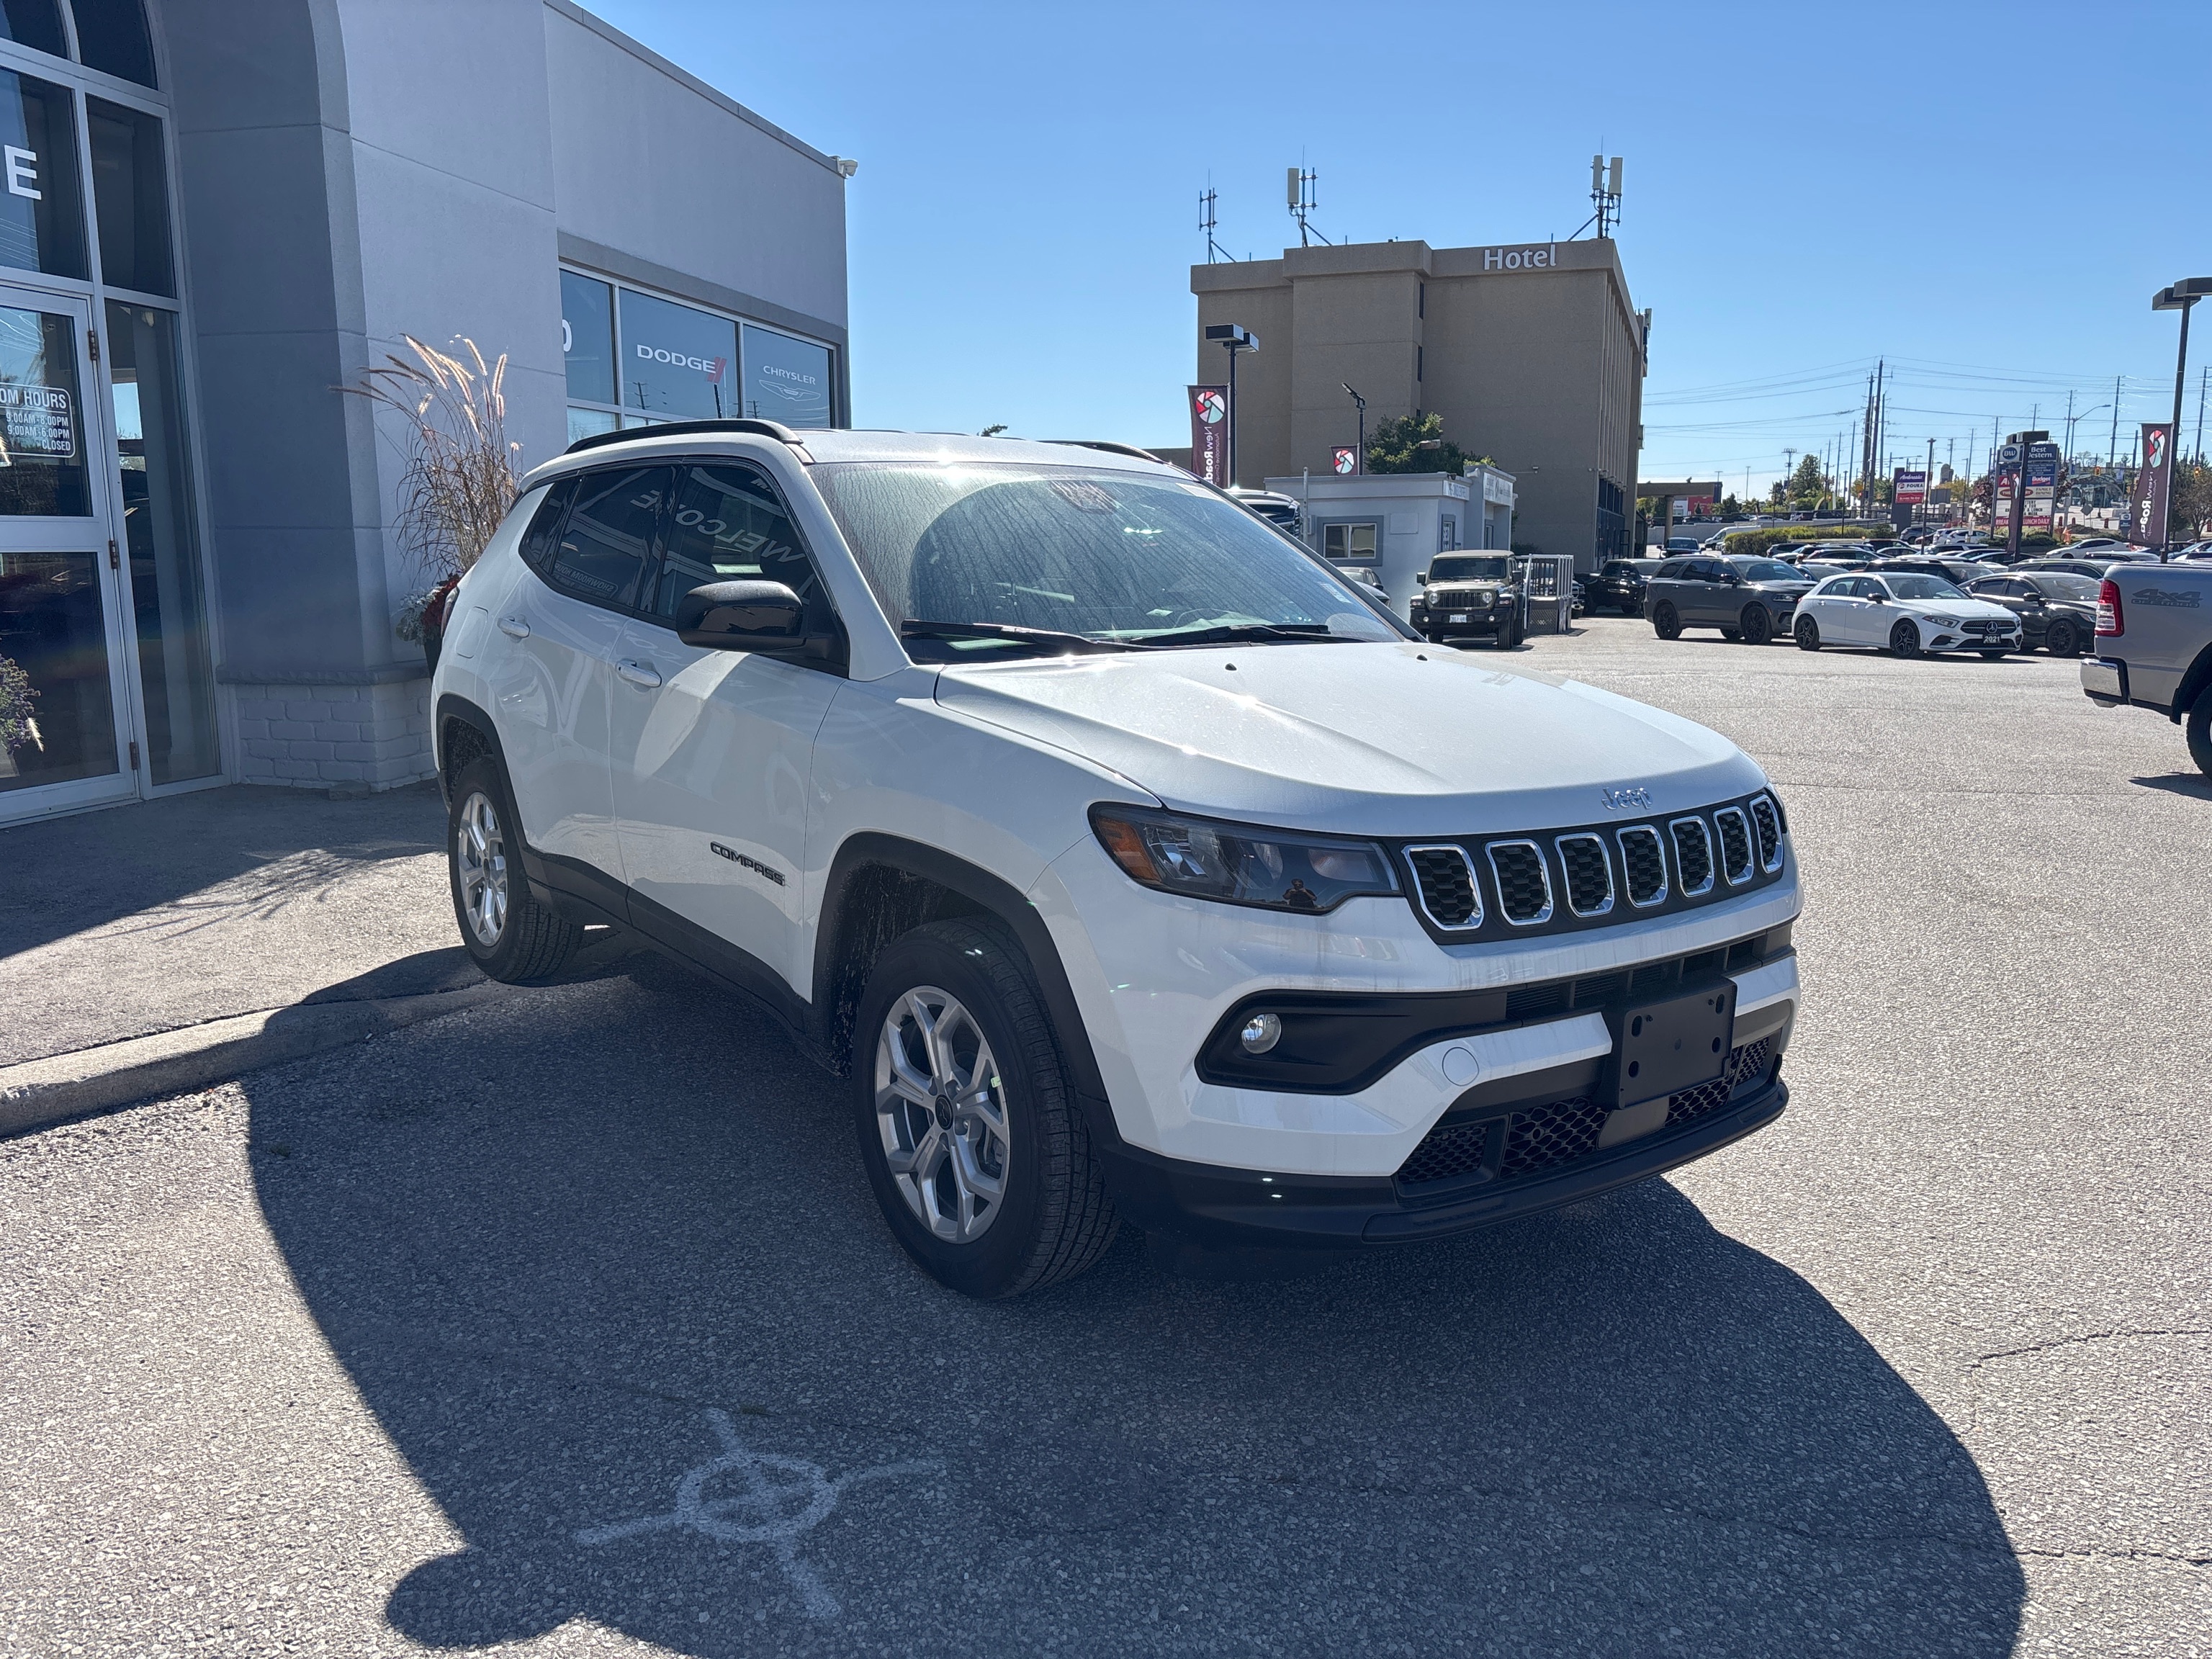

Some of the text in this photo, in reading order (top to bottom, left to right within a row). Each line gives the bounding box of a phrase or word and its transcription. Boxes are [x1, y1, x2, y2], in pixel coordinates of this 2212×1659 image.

[1484, 244, 1557, 270] Hotel
[637, 343, 716, 374] DODGE
[763, 365, 816, 385] CHRYSLER
[23, 390, 67, 409] HOURS
[42, 439, 71, 451] CLOSED
[2132, 588, 2204, 602] 4x4
[2160, 600, 2200, 608] ROAD
[1601, 787, 1653, 811] Jeep
[710, 841, 786, 886] COMPASS
